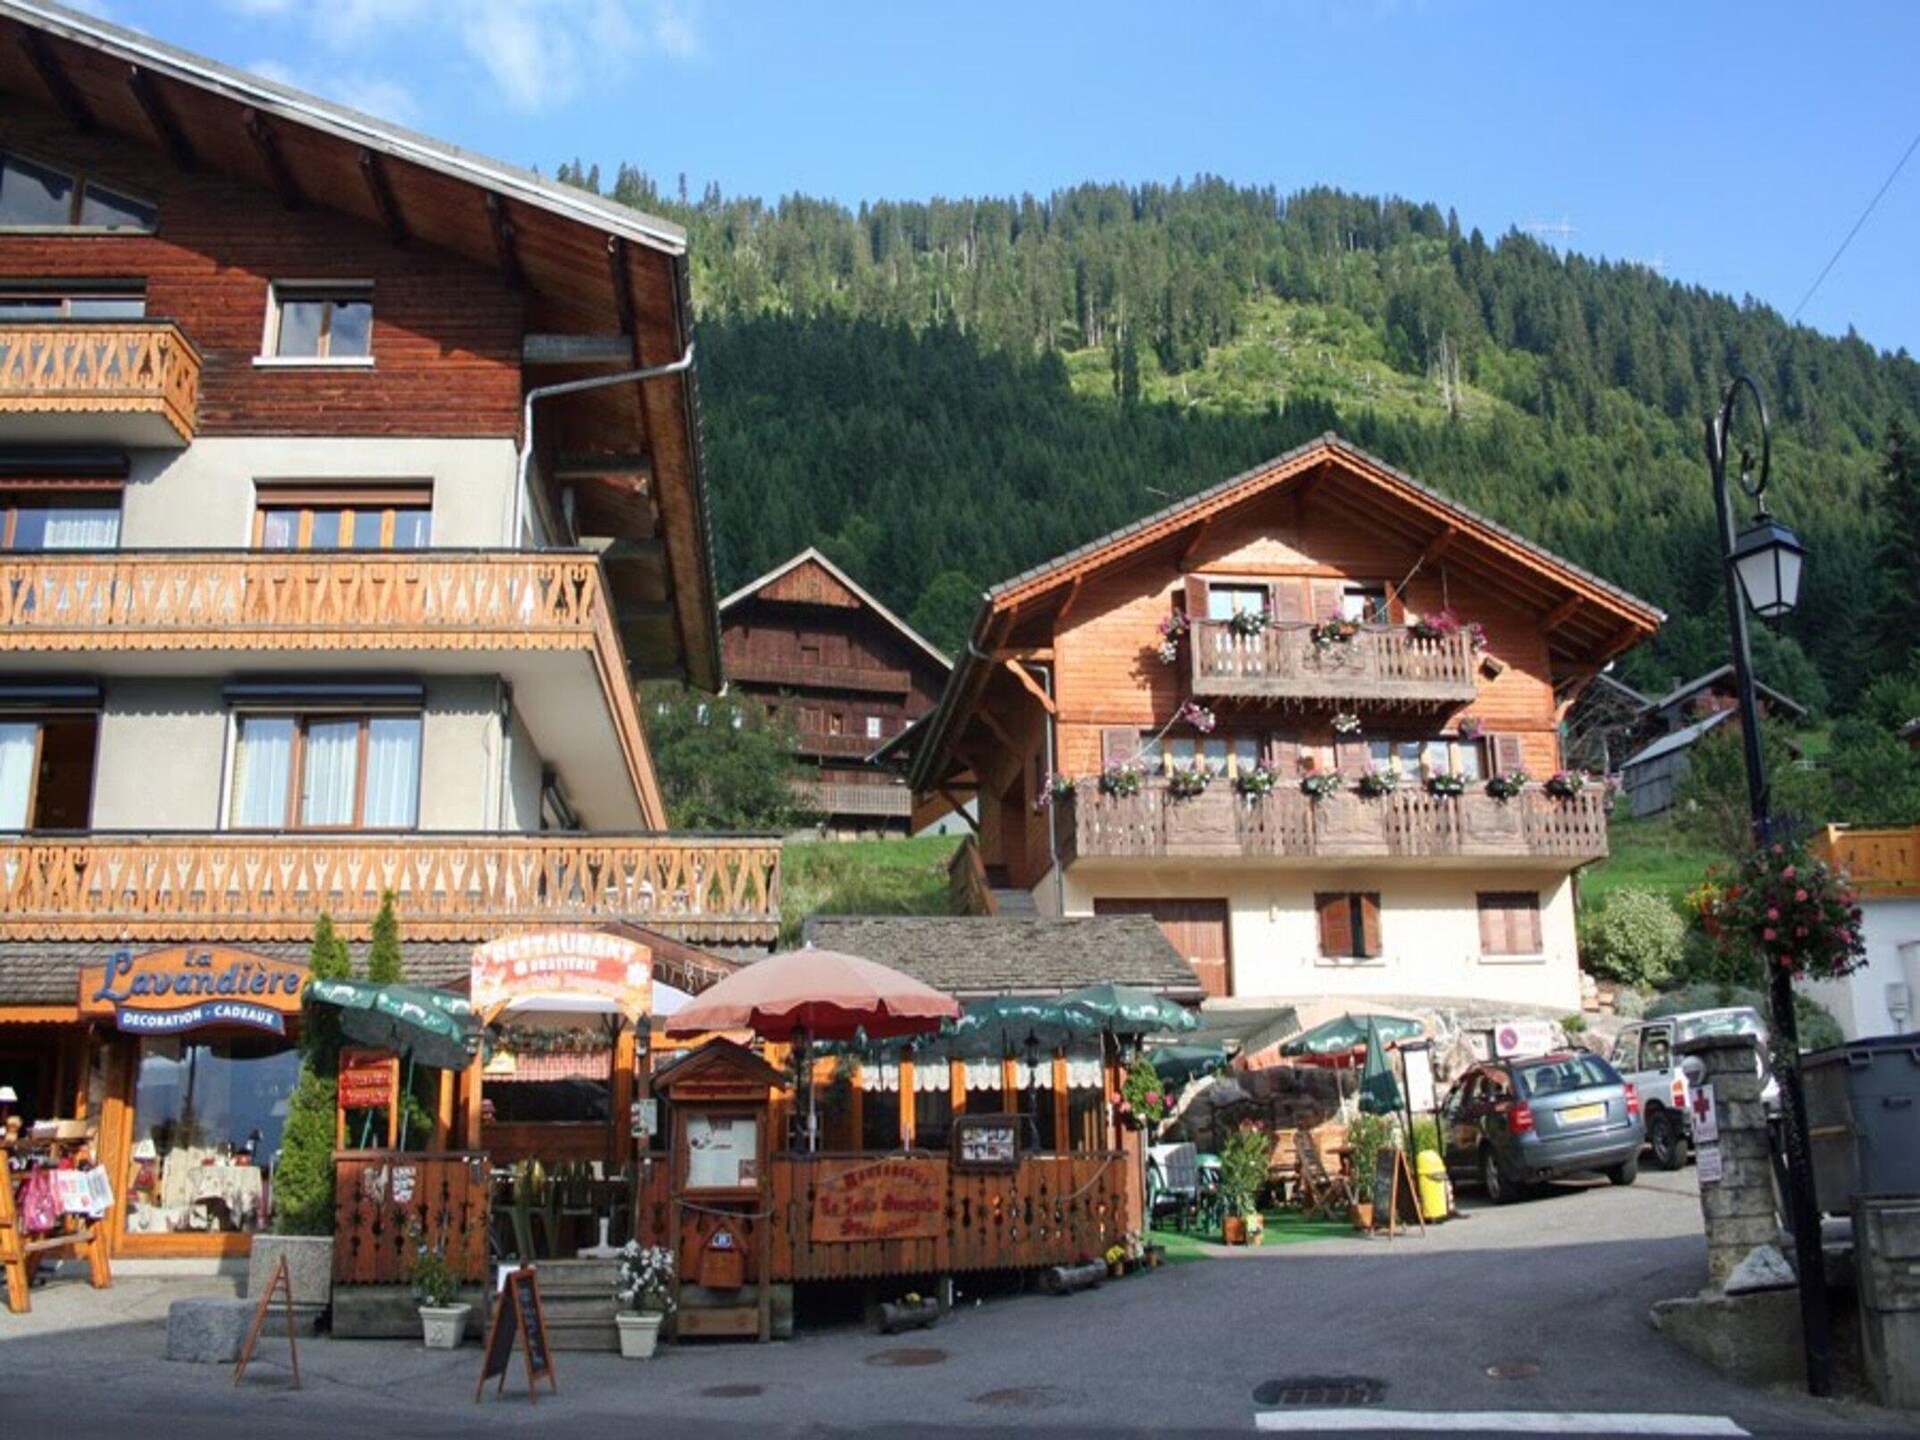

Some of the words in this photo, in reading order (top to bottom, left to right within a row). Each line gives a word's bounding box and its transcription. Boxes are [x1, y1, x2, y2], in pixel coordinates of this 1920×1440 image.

[93, 951, 300, 1002] Lavandière
[123, 1010, 203, 1027] DECORATION
[214, 1004, 274, 1026] CADEAUX
